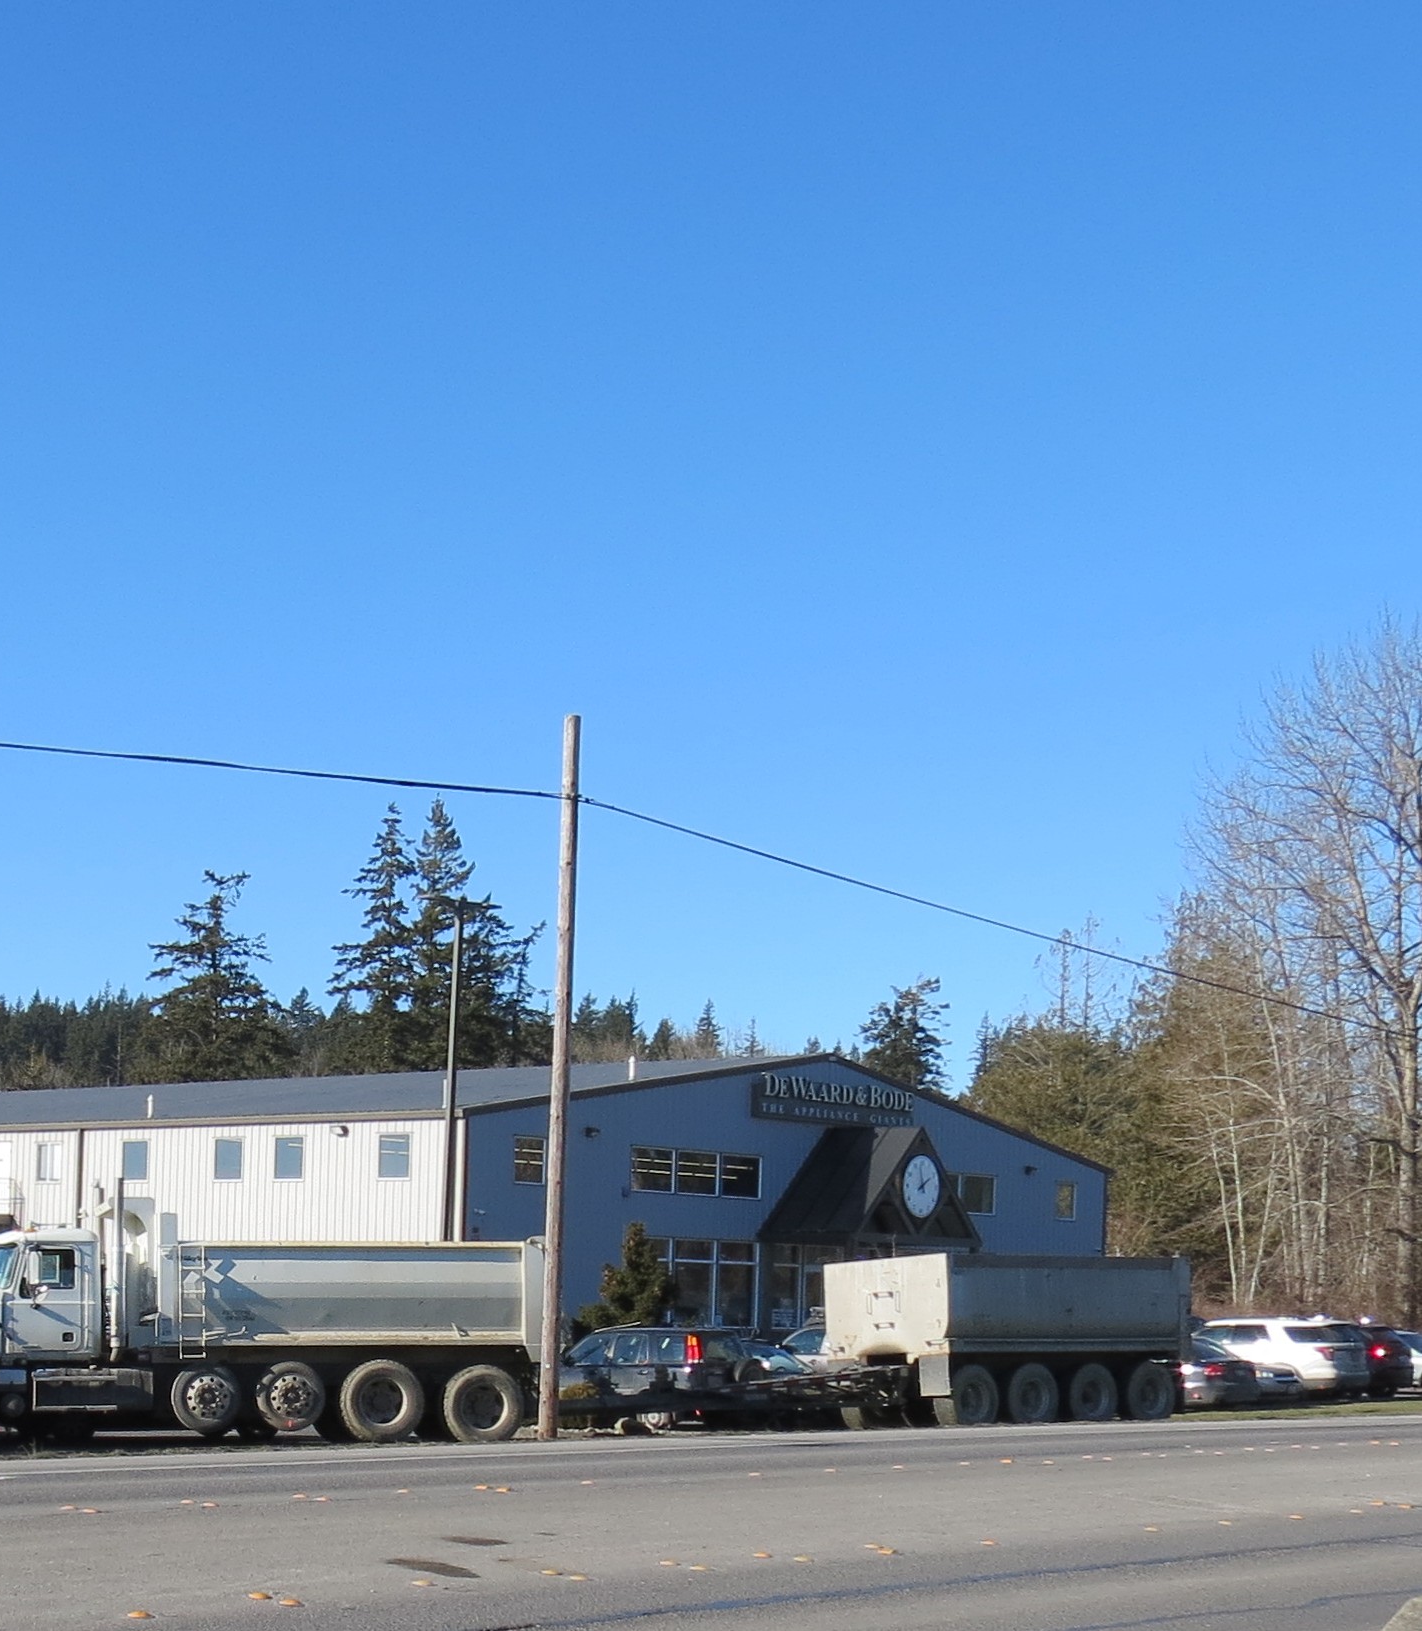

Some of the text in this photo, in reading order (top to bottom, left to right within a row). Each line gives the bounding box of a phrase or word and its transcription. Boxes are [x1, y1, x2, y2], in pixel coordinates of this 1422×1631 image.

[855, 1085, 867, 1106] &
[869, 1085, 915, 1112] BODE
[762, 1102, 912, 1127] THE APPLIANCE GIANTS
